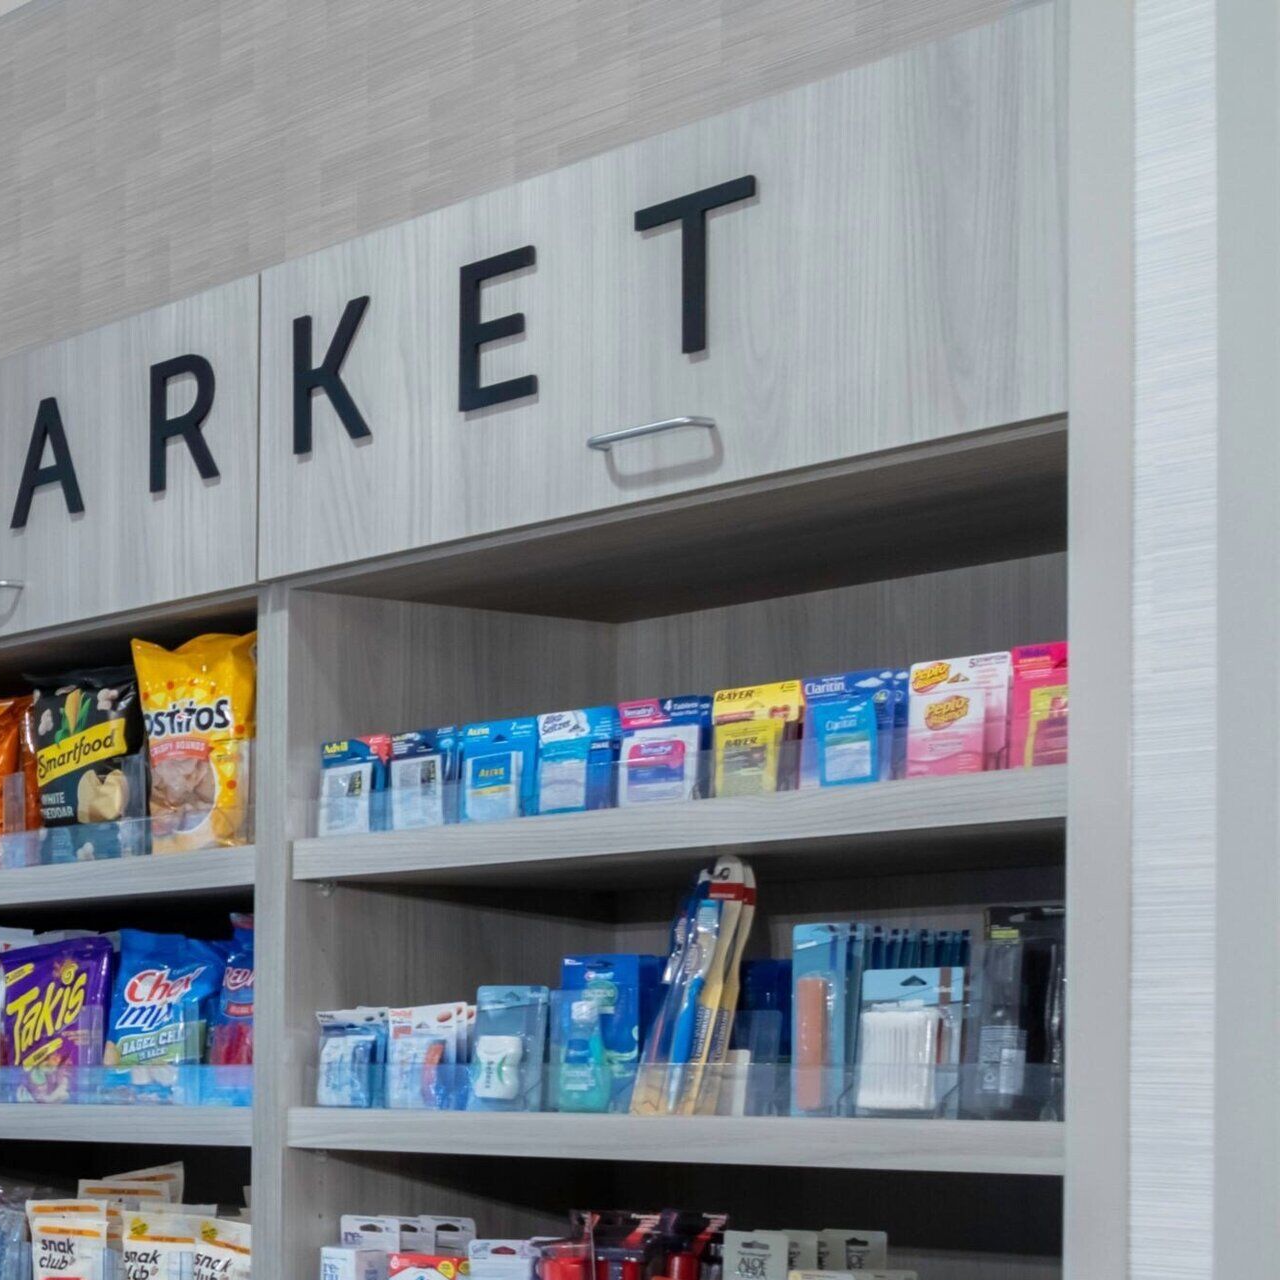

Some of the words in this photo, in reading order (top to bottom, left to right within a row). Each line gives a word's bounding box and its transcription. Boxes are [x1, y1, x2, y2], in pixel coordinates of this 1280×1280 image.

[716, 690, 754, 701] BAYER
[805, 681, 846, 695] Claritin
[38, 729, 116, 779] Smartfood
[41, 1238, 75, 1254] snak
[39, 1254, 69, 1270] club
[123, 1250, 161, 1265] snak
